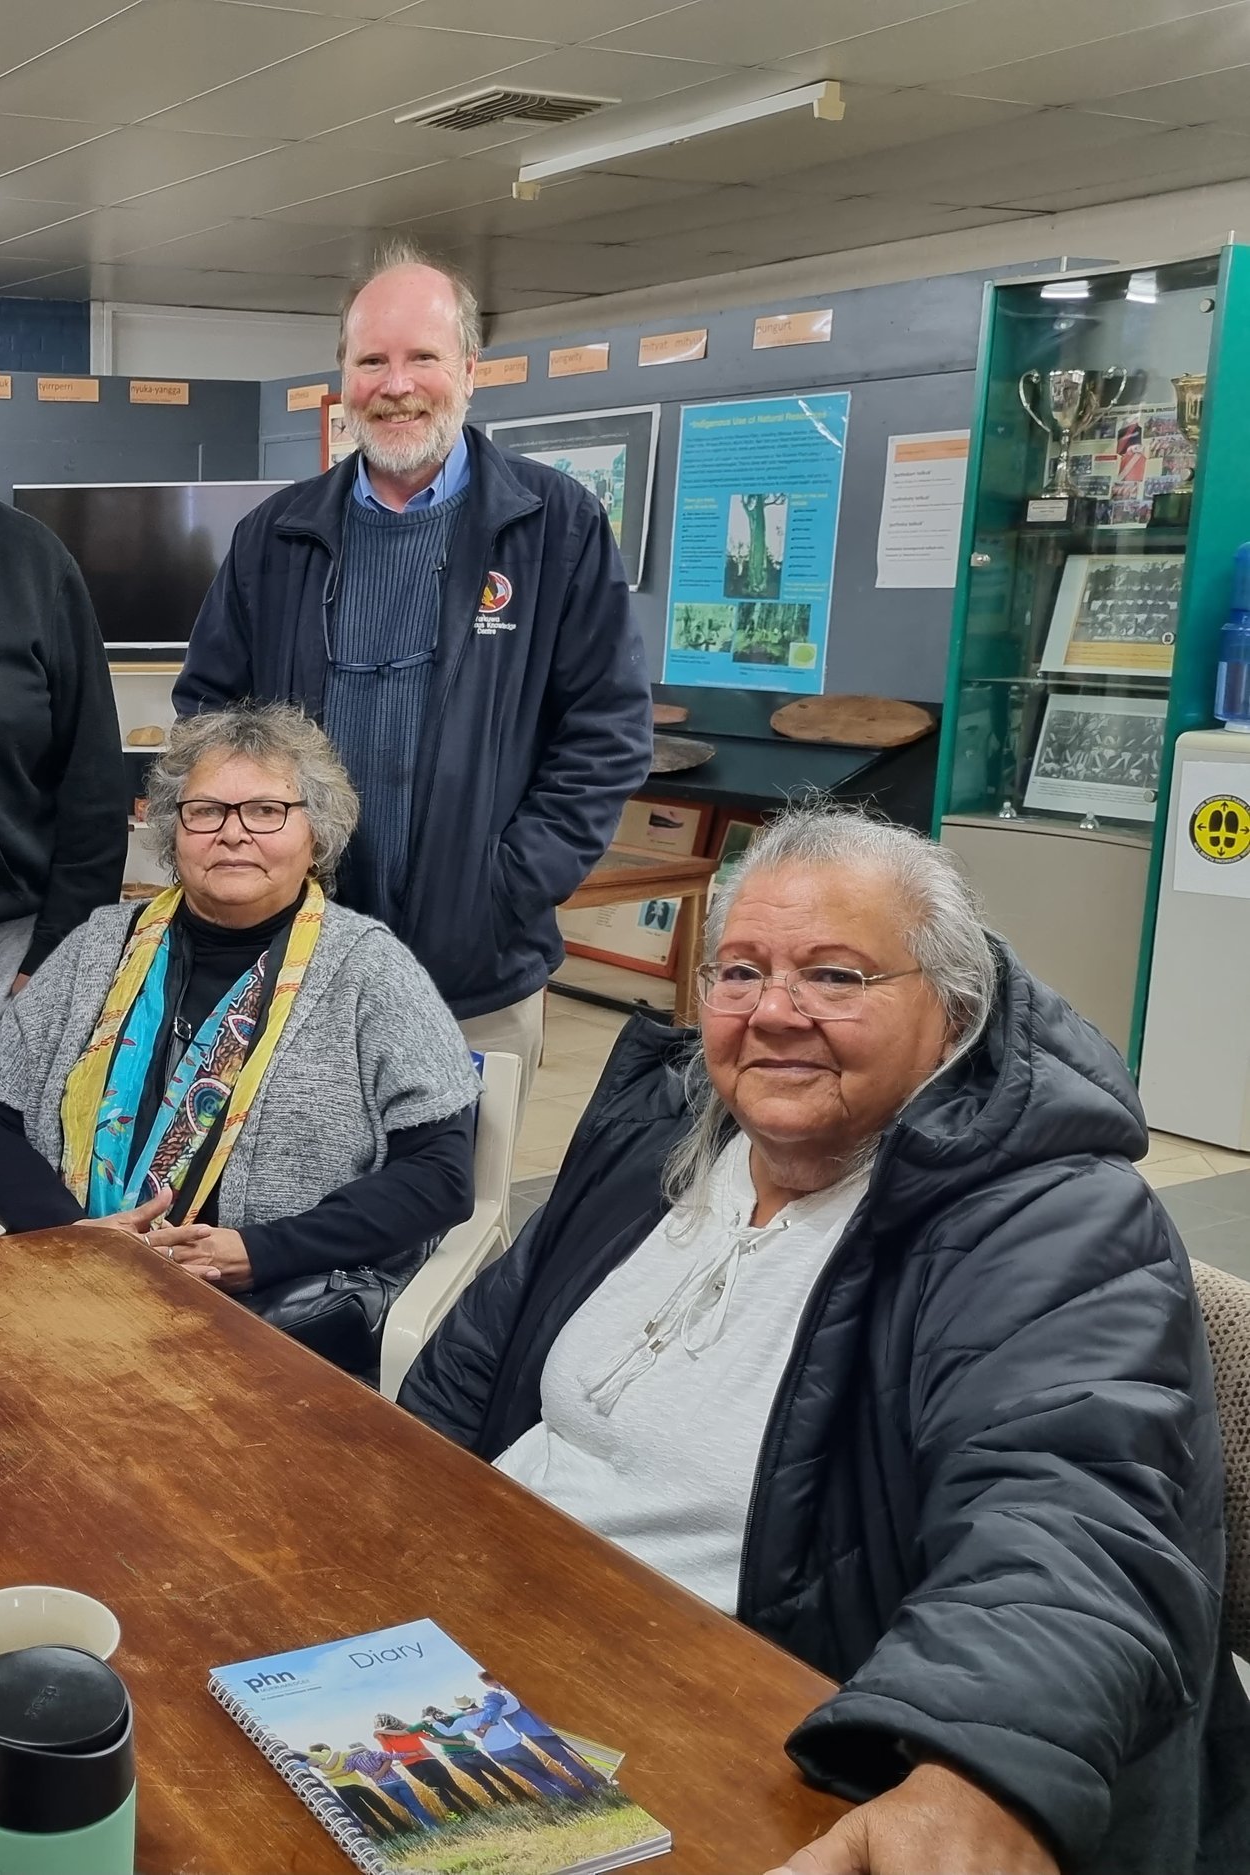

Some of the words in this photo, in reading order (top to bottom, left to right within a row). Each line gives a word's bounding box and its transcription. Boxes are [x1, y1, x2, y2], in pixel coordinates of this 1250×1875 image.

[748, 416, 756, 424] of
[757, 414, 784, 423] Natural
[348, 1641, 424, 1669] Diary
[243, 1670, 296, 1694] phn
